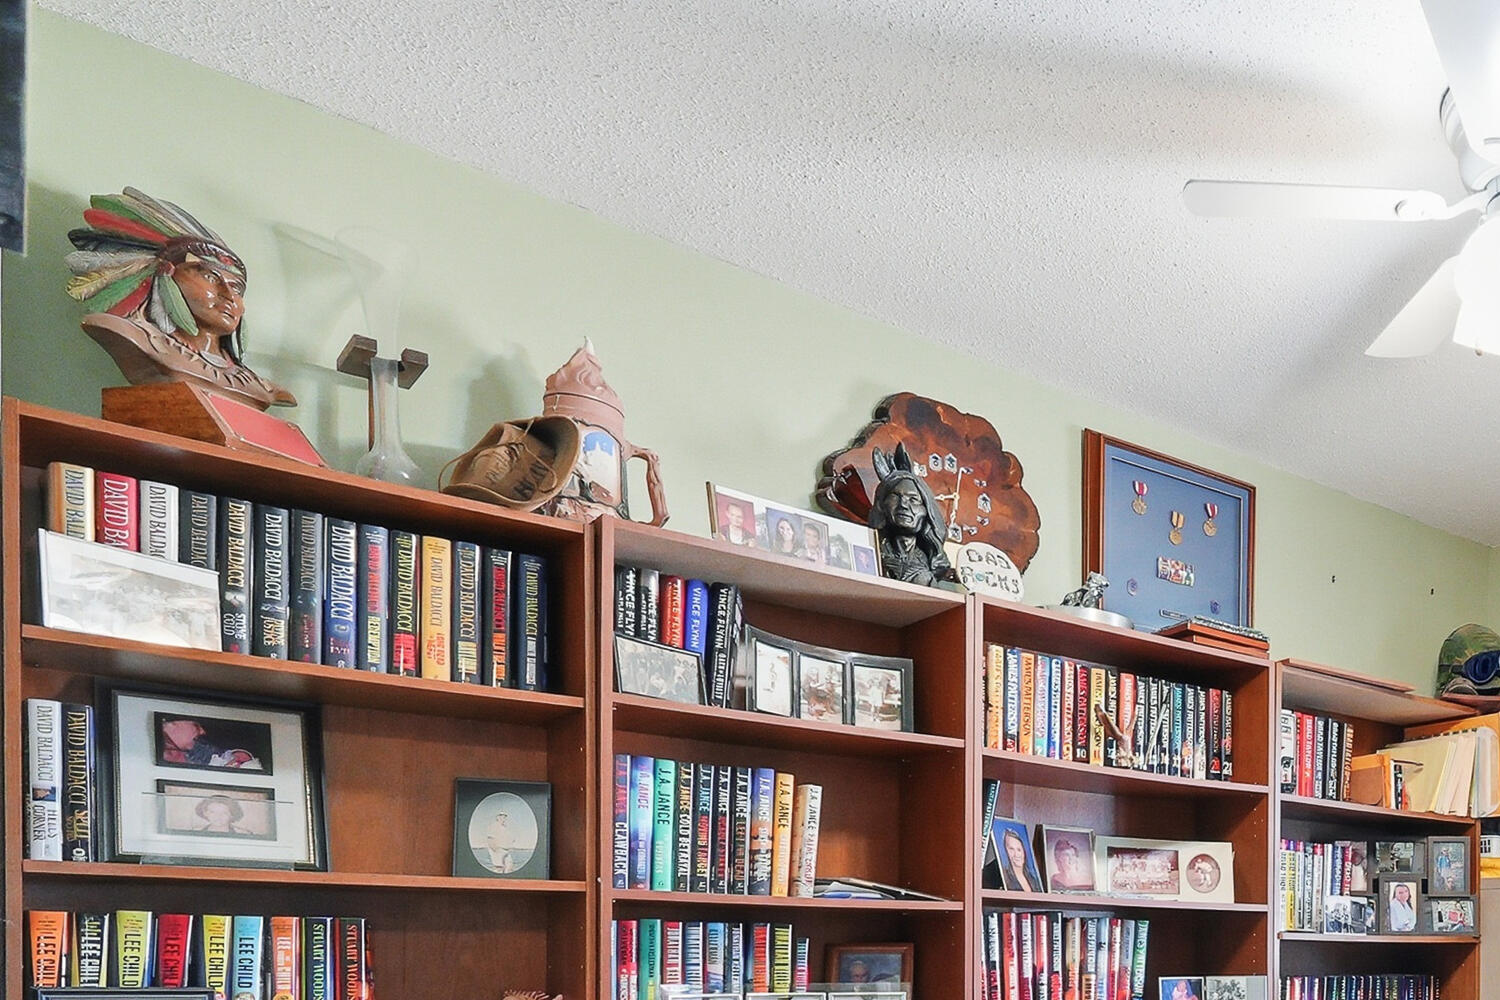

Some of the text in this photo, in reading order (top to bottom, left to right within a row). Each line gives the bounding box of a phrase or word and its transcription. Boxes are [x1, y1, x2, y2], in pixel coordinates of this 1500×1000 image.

[65, 469, 84, 506] DAVID
[104, 478, 128, 523] DAVID
[149, 485, 167, 521] DAVID
[192, 495, 208, 525] DAVID
[228, 502, 245, 589] DAVID BALDACCI
[265, 513, 283, 601] DAVID BALDACCI
[300, 515, 316, 592] DAVID BALDACCI
[331, 525, 355, 561] DAVID
[966, 549, 1011, 569] DAD
[431, 557, 444, 582] DAVID
[526, 571, 538, 601] DAVID
[330, 562, 355, 623] BALDACCI
[397, 549, 415, 633] DAVID BALDACCI
[430, 586, 443, 628] BALDACCI
[459, 554, 475, 639] DAVID BALDACCI
[223, 613, 235, 636] COLD
[234, 613, 246, 641] STONE
[263, 615, 277, 647] JUSTICE
[526, 602, 538, 635] BALDACCI
[690, 587, 702, 649] VINCE FLYNN
[714, 587, 729, 650] VINCE FLYNN
[367, 615, 380, 665] REDEMPTION
[1005, 653, 1019, 736] JAMES PATTERSON
[1022, 657, 1034, 737] JAMES PATTERSON
[66, 711, 86, 745] DAVID
[1075, 698, 1088, 747] PATTERSON
[36, 705, 53, 782] DAVID BALDACCI
[1304, 740, 1313, 769] TAYLOR
[66, 748, 87, 807] BALDACCI
[657, 767, 672, 788] J.A.
[780, 781, 790, 797] J.A.
[656, 789, 671, 825] JANCE
[718, 787, 730, 813] JANCE
[735, 790, 749, 818] JANCE
[758, 795, 771, 822] JANCE
[778, 800, 790, 829] JANCE
[806, 803, 818, 831] JANCE
[36, 803, 46, 843] CORNER
[73, 808, 89, 844] SPLIT
[677, 784, 692, 878] JANCE COLD BETRAYAL
[696, 785, 711, 878] JANCE MOVING TARGET
[613, 821, 628, 876] CLAWBACK
[37, 935, 56, 956] LEE
[80, 934, 101, 957] LEE
[122, 933, 142, 987] LEE CHILD
[163, 937, 181, 957] LEE
[238, 937, 255, 957] LEE
[277, 936, 292, 950] LEE
[312, 923, 325, 962] STUART
[345, 924, 358, 962] STUART
[774, 927, 790, 964] JONATHAN
[208, 936, 226, 989] LEE CHILD
[237, 960, 255, 989] CHILD
[276, 966, 292, 990] CHILD
[1133, 949, 1147, 994] PATTERSON
